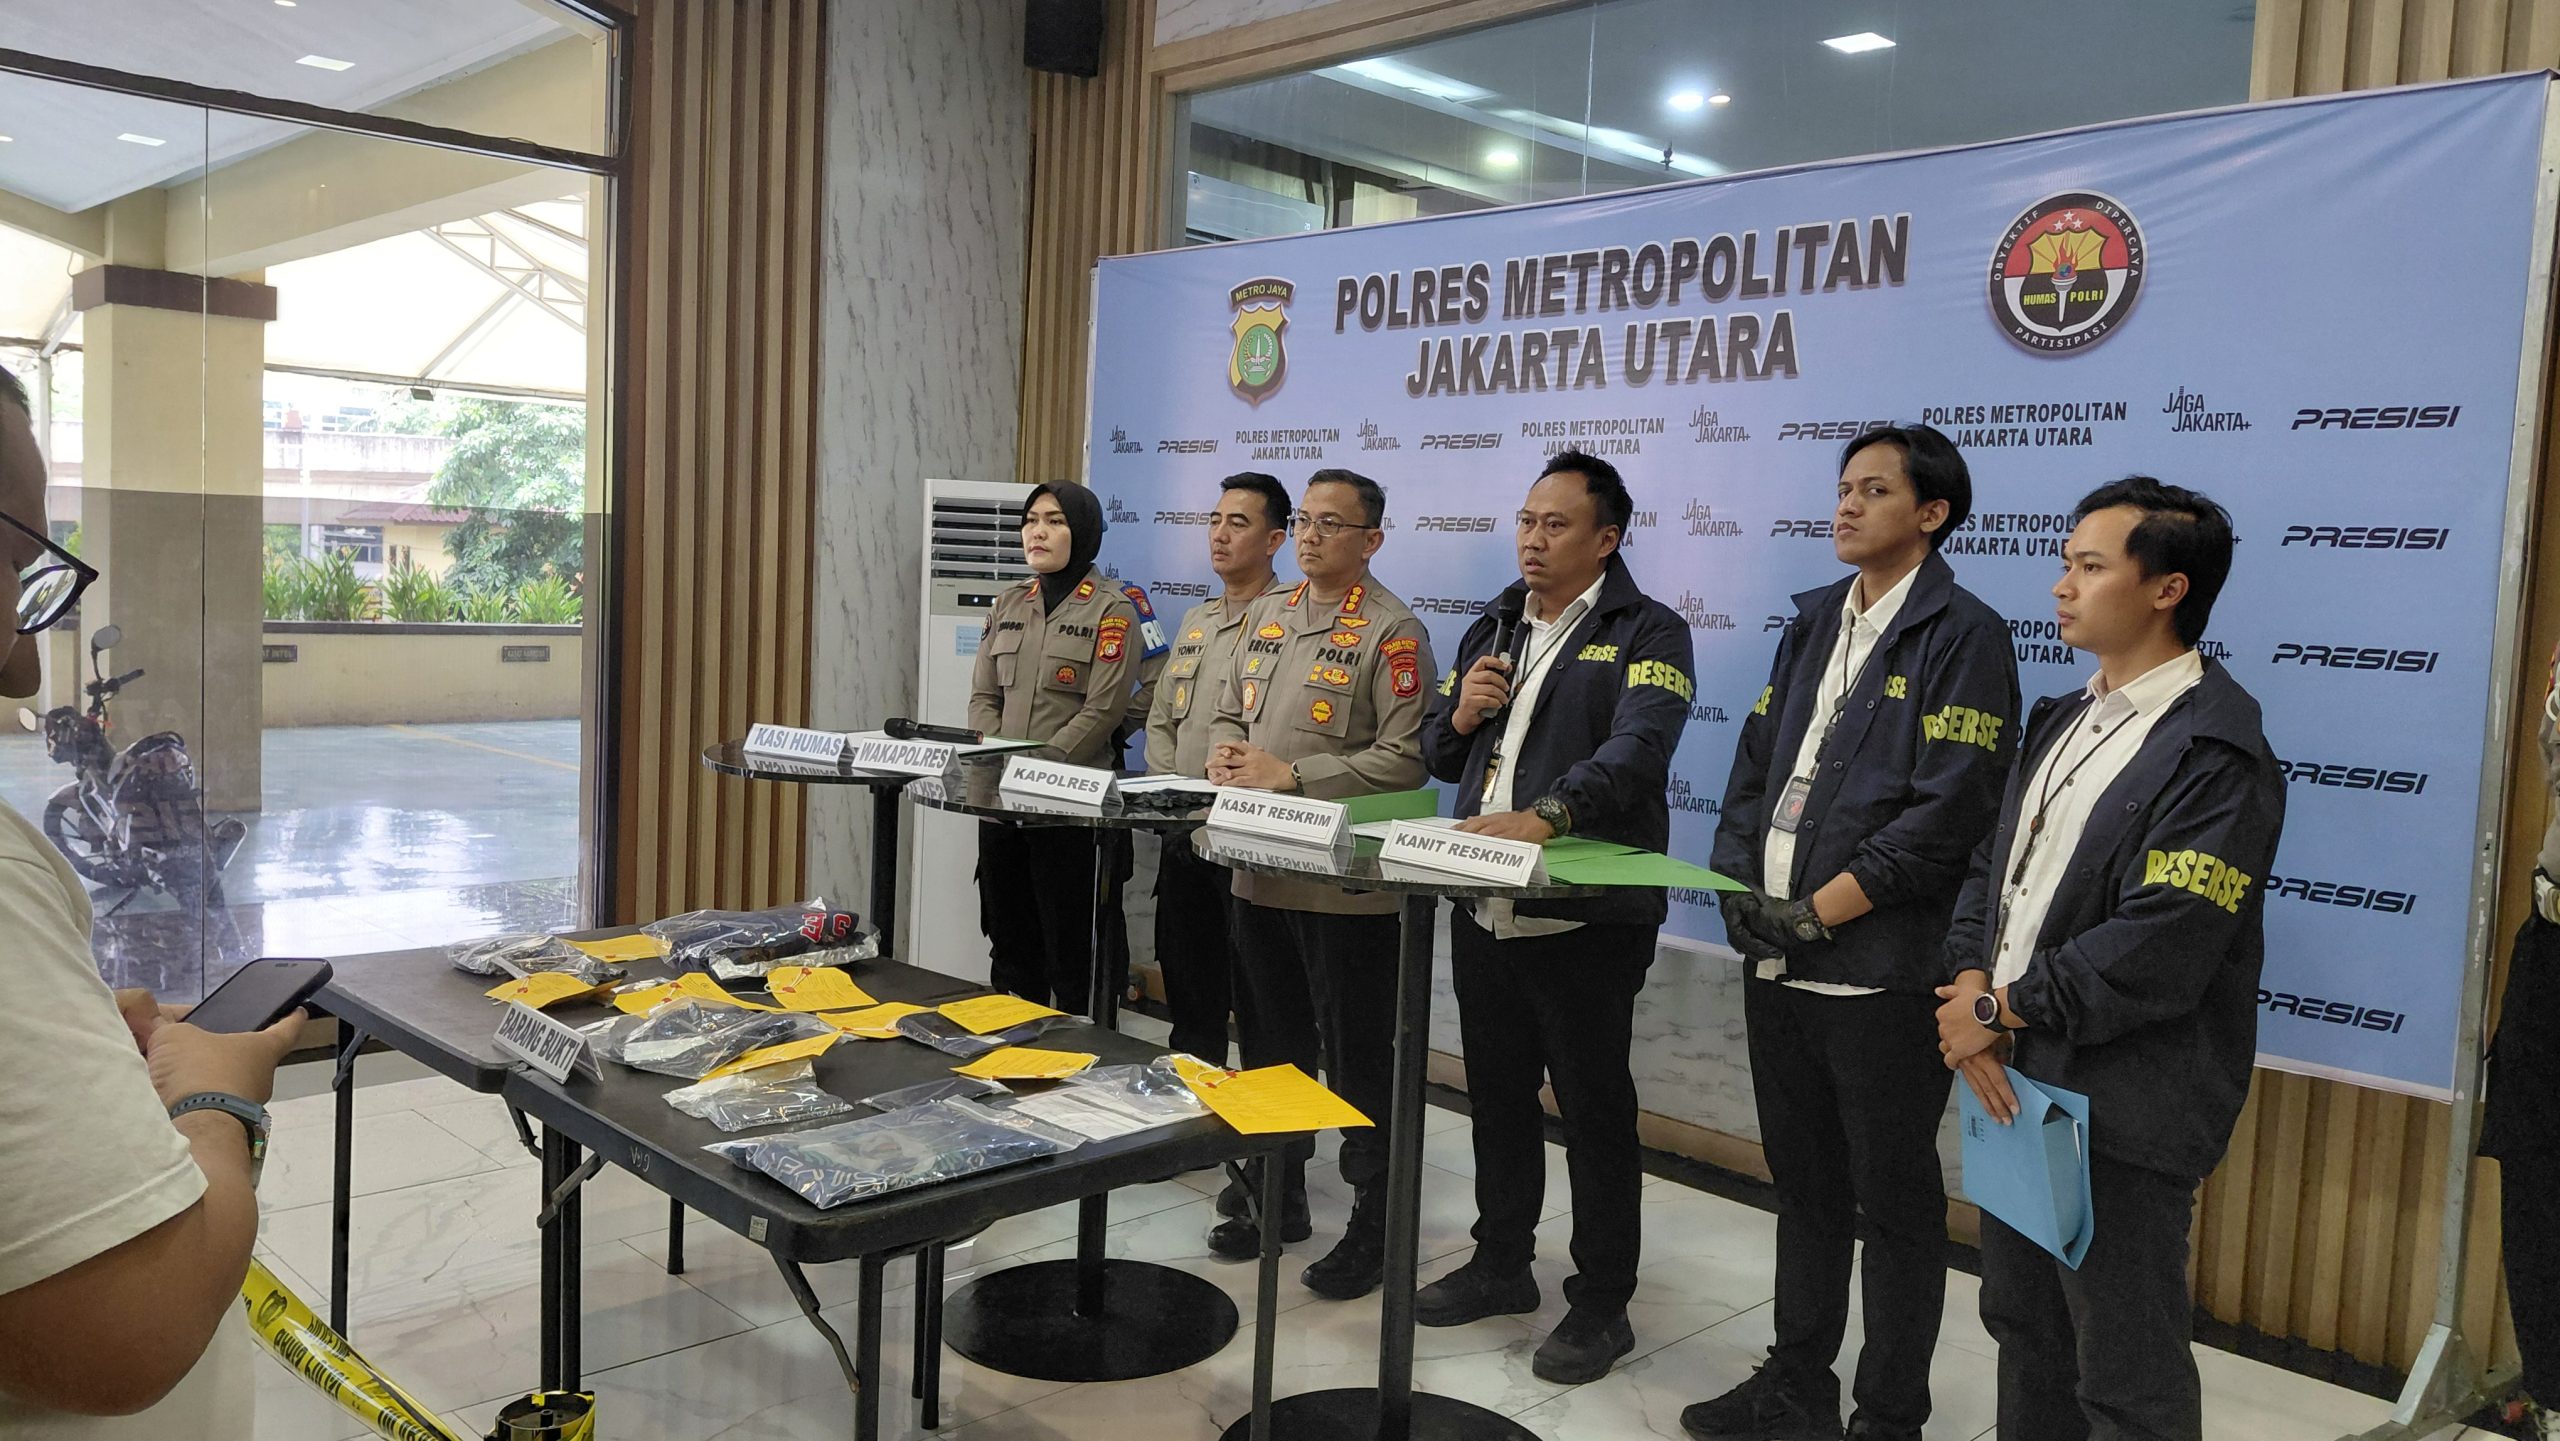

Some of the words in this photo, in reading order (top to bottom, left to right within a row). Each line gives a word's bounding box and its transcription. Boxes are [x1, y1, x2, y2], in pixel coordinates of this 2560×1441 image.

[1993, 210, 2039, 281] OBYEKTIF
[2095, 201, 2140, 277] DIPERCAYA
[1336, 263, 1490, 333] POLRES
[1503, 215, 1910, 319] METROPOLITAN
[1235, 284, 1266, 301] METRO
[1267, 283, 1287, 297] JAYA
[2023, 293, 2057, 306] HUMAS
[2070, 290, 2104, 303] POLRI
[2014, 322, 2107, 348] PARTISIPASI
[1407, 328, 1606, 398] JAKARTA
[1624, 311, 1798, 387] UTARA
[2162, 386, 2205, 414] JAGA
[1689, 404, 1718, 428] JAGA
[1922, 406, 1985, 426] POLRES
[1990, 402, 2127, 423] METROPOLITAN
[2291, 406, 2461, 430] PRESISI
[1235, 430, 1269, 444] POLRES
[1270, 428, 1340, 443] METROPOLITAN
[1521, 421, 1566, 437] POLRES
[1569, 418, 1665, 436] METROPOLITAN
[1952, 428, 2029, 448] JAKARTA
[2035, 427, 2093, 446] UTARA
[1157, 439, 1219, 453] PRESISI
[1420, 432, 1503, 450] PRESISI
[1600, 438, 1641, 455] UTARA
[1251, 446, 1291, 460] JAKARTA
[1292, 446, 1323, 460] UTARA
[1153, 511, 1211, 525] PRESIS
[1415, 516, 1499, 533] PRESISI
[1944, 537, 2020, 555] JAKARTA
[2281, 525, 2450, 550] PRESISI
[1150, 581, 1211, 598] PRESISI
[1411, 597, 1487, 615] PRESIS
[1058, 624, 1094, 639] POLRI
[1247, 639, 1284, 655] ERICK
[1315, 647, 1362, 667] POLRI
[2017, 643, 2076, 665] UTARA
[2271, 643, 2439, 673] PRESISI
[1627, 659, 1694, 704] RESERS
[754, 727, 789, 749] KASI
[790, 733, 842, 757] HUMAS
[858, 741, 949, 770] WAKAPOLRES
[1013, 766, 1101, 793] KAPOLRES
[1219, 798, 1264, 816] KASAT
[1267, 807, 1332, 828] RESKRIM
[1395, 832, 1447, 853] KANIT
[1448, 843, 1525, 869] RESKRIM
[498, 1007, 547, 1053] BARANG
[537, 1028, 580, 1071] BUKTI
